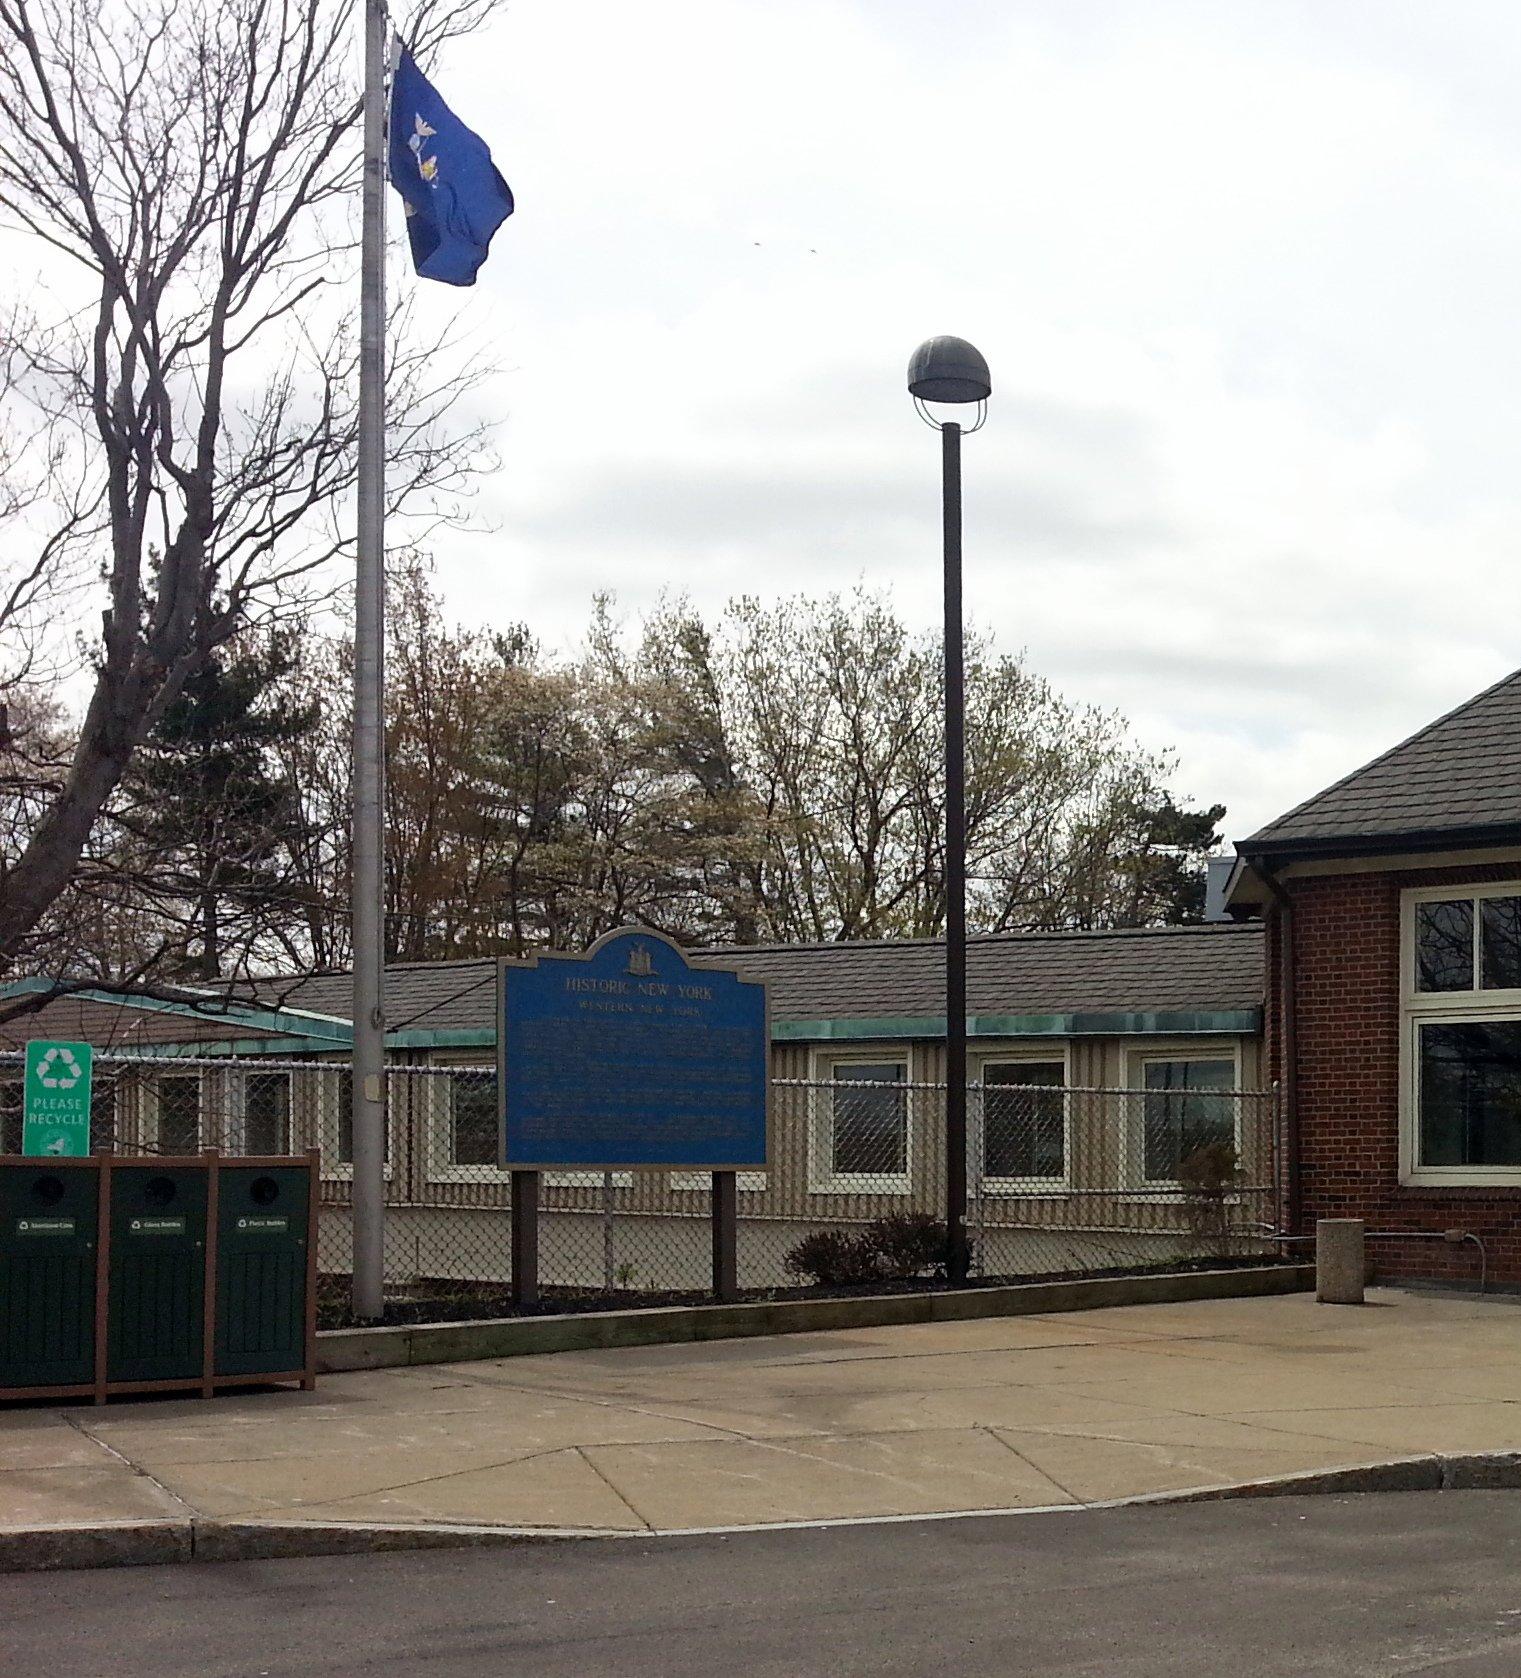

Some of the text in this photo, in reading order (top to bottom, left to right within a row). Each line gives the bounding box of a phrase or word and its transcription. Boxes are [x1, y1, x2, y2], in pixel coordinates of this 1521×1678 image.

[566, 977, 713, 1000] HISTORIC NEW YORK
[579, 1000, 633, 1013] WESTERN
[641, 1003, 664, 1015] NEW
[33, 1097, 82, 1110] PLEASE
[28, 1112, 84, 1125] RECYCLE
